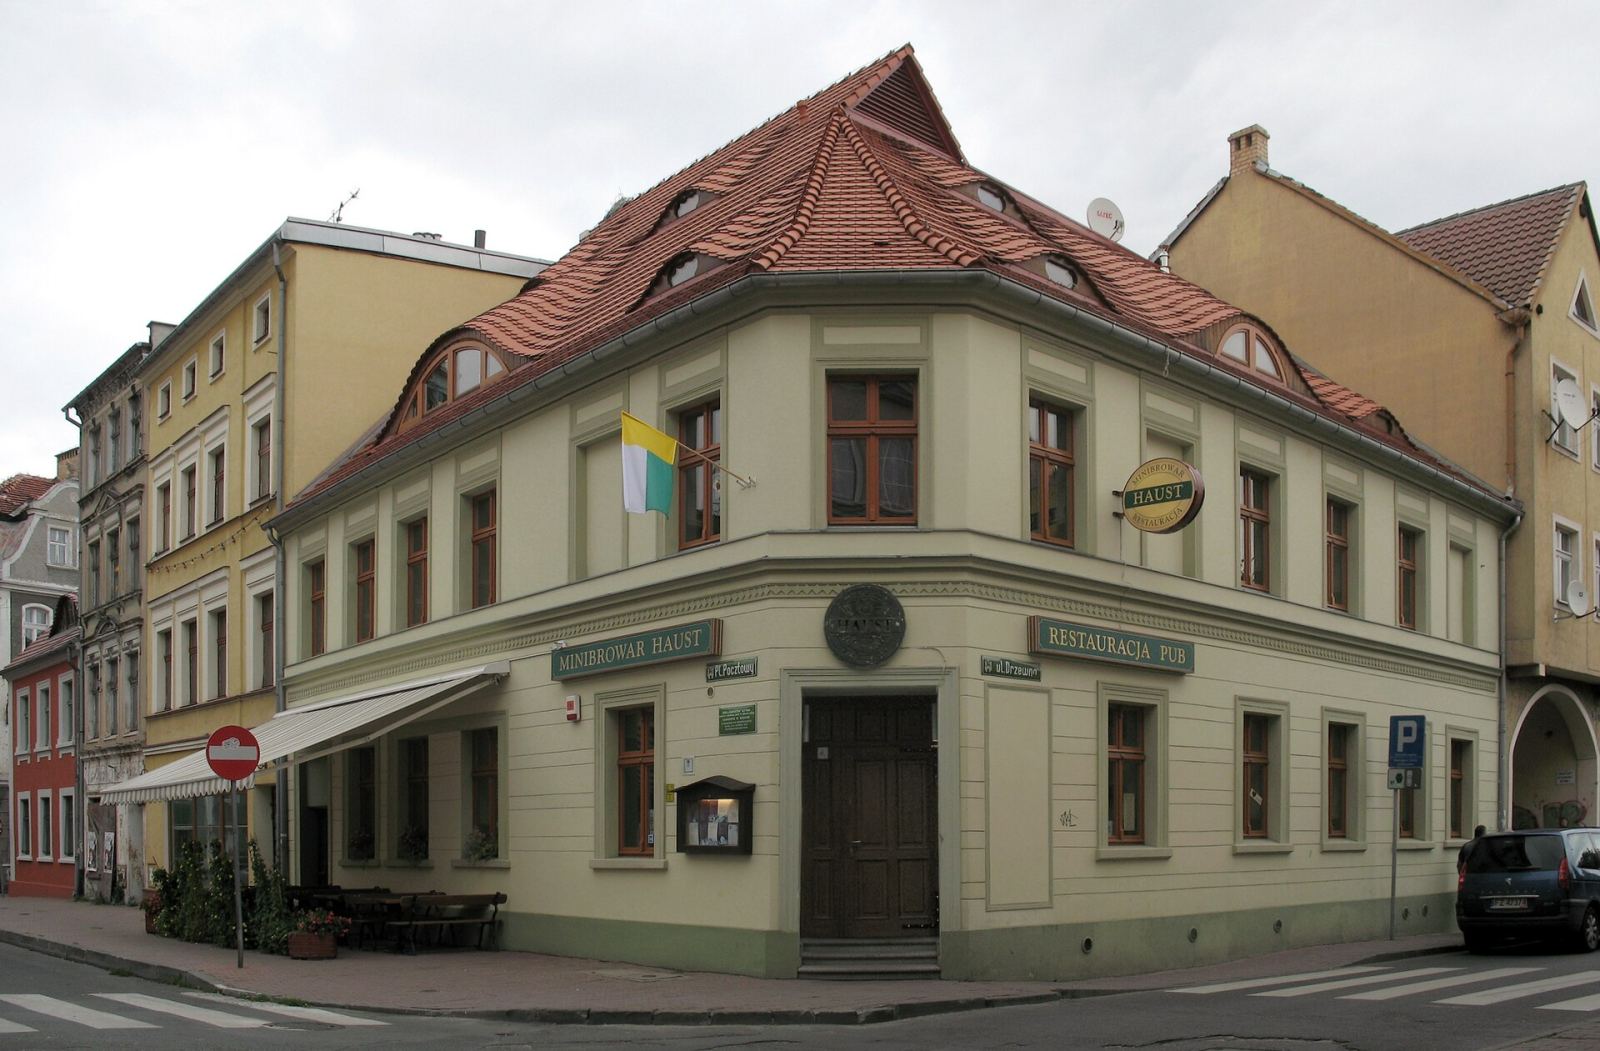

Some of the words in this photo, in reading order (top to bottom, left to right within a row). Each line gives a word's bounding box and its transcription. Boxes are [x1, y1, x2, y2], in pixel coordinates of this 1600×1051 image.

[1131, 463, 1185, 485] MINIBROWAR
[1133, 484, 1184, 505] HAUST
[559, 640, 645, 671] MINIBROWAR
[652, 629, 702, 654] HAUST
[1048, 626, 1151, 660] RESTAURACJA
[1159, 644, 1186, 664] PUB
[1397, 720, 1418, 753] P
